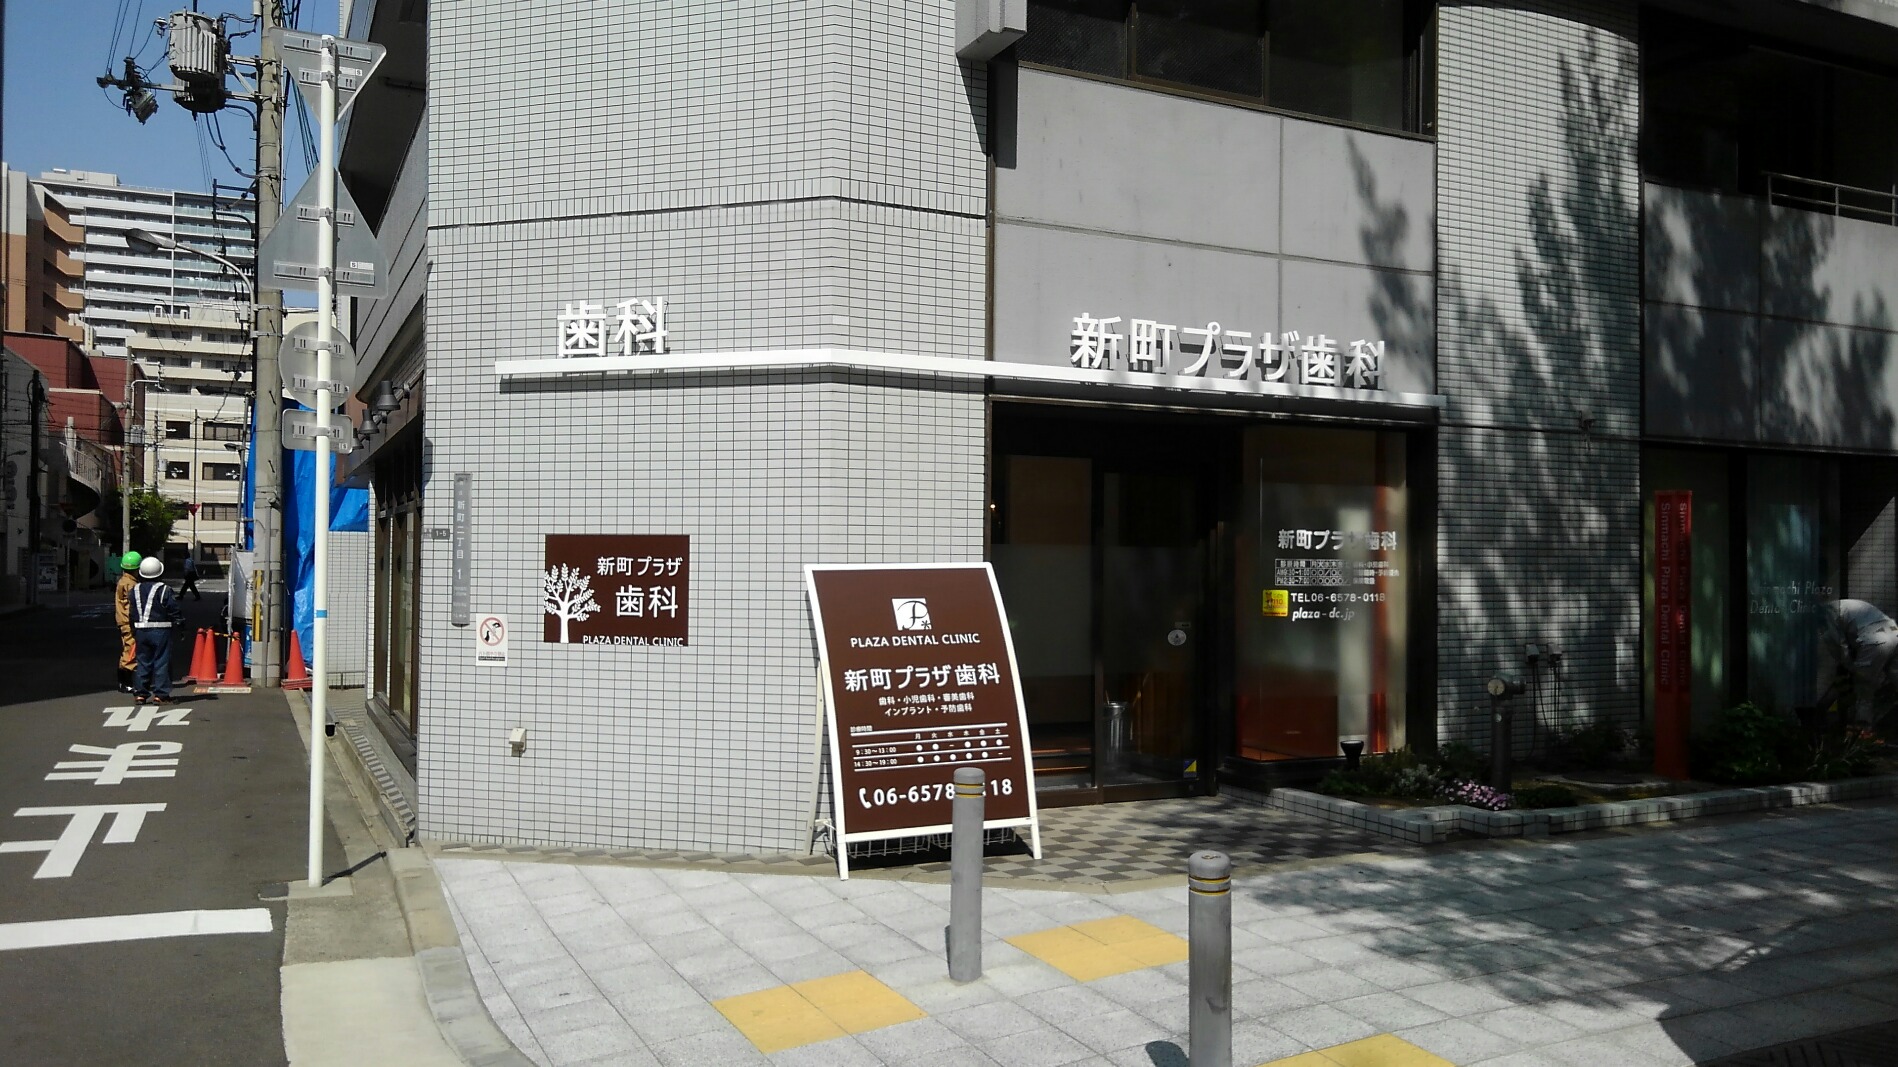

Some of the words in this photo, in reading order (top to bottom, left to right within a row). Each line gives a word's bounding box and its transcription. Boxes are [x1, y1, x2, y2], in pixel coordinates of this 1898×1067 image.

[557, 296, 669, 357] 歯科
[1071, 312, 1387, 388] 新町プラザ歯科
[597, 556, 684, 577] 新町プラザ
[1660, 566, 1671, 599] Plaza
[615, 584, 679, 619] 歯科
[582, 635, 612, 645] PLAZA
[614, 636, 650, 646] DENTAL
[652, 637, 684, 647] CLINIC
[850, 635, 890, 648] PLAZA
[892, 634, 938, 647] DENTAL
[942, 633, 981, 645] CLINIC
[1660, 604, 1671, 644] Dental
[844, 662, 1001, 692] 新町プラザ歯科
[1660, 649, 1671, 685] Clinic
